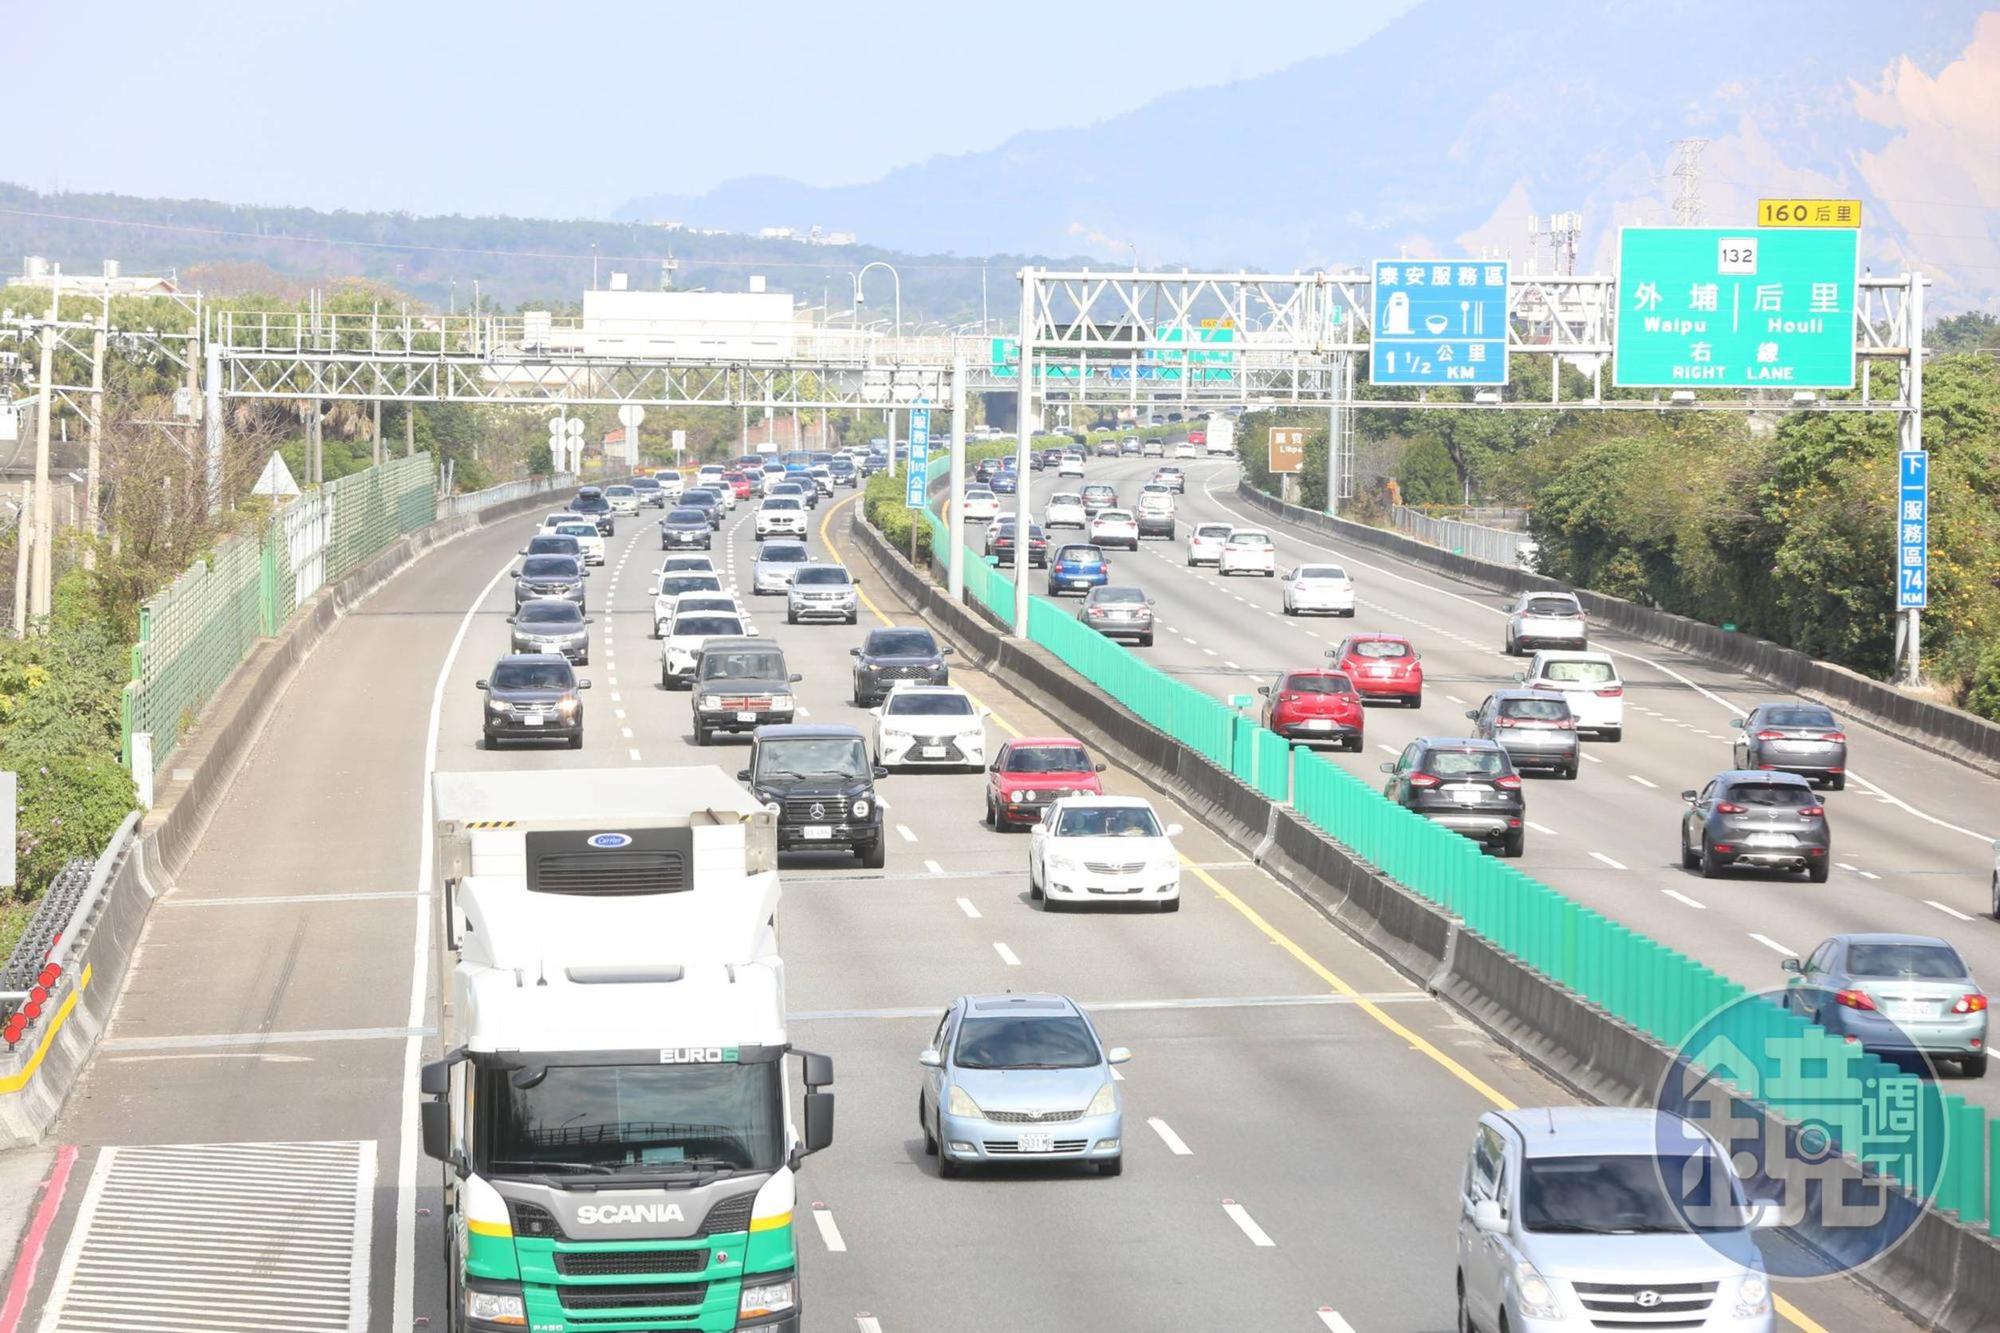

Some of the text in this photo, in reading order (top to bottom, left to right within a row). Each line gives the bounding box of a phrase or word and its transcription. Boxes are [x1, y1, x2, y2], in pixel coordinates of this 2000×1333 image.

[1766, 204, 1852, 222] 160 后里
[1722, 248, 1753, 263] 132
[1379, 265, 1505, 287] 泰安服務區
[1633, 282, 1840, 313] 外埔 后里
[1644, 317, 1824, 335] Waipu Houli
[1436, 344, 1487, 361] 公里
[1446, 366, 1475, 379] KM
[1672, 366, 1795, 380] RIGHT LANE
[1902, 569, 1923, 590] 74
[1902, 592, 1923, 604] KM
[598, 836, 622, 846] Carrier
[577, 1203, 685, 1225] SCANIA
